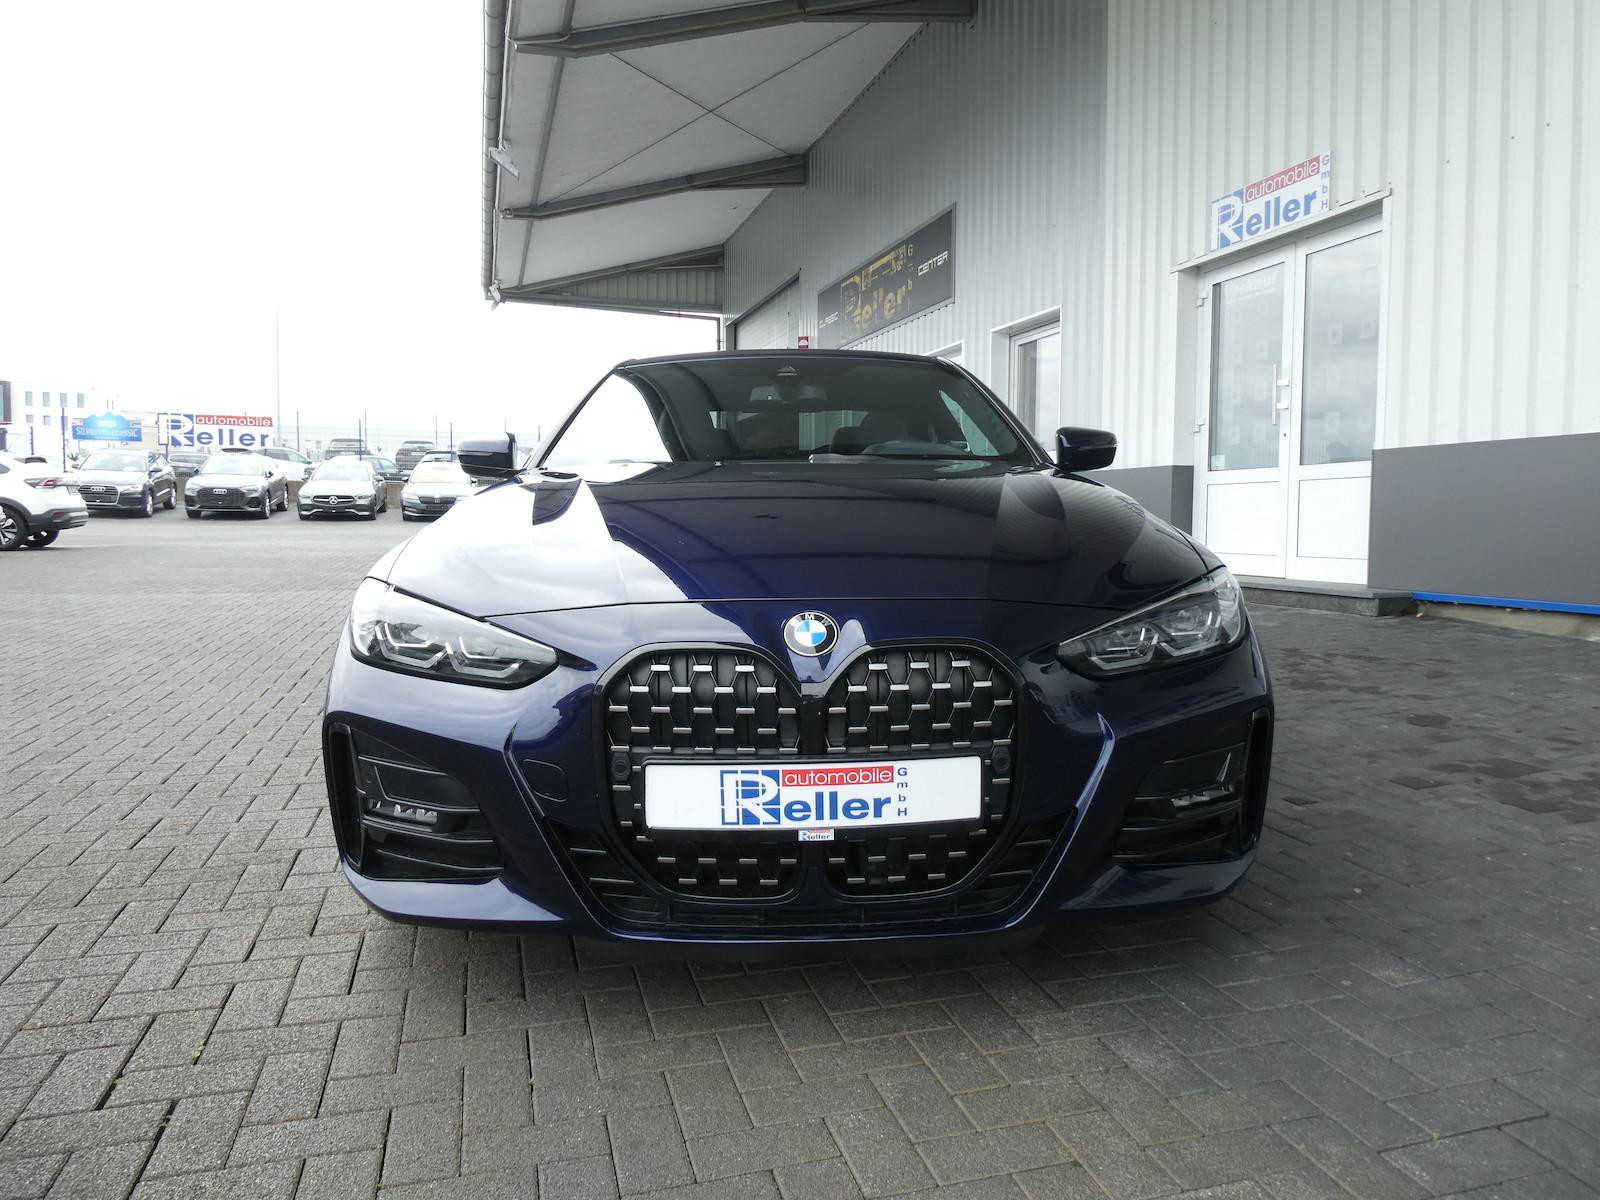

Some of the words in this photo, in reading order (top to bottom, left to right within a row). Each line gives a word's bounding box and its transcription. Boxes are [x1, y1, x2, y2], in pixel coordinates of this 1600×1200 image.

[1246, 161, 1318, 201] automobile
[1210, 188, 1317, 252] Reller
[918, 250, 948, 276] CENTER
[158, 413, 269, 446] Reller
[196, 416, 272, 426] automobile
[784, 768, 892, 785] automobile
[896, 767, 908, 817] GmbH
[720, 769, 892, 825] Reller
